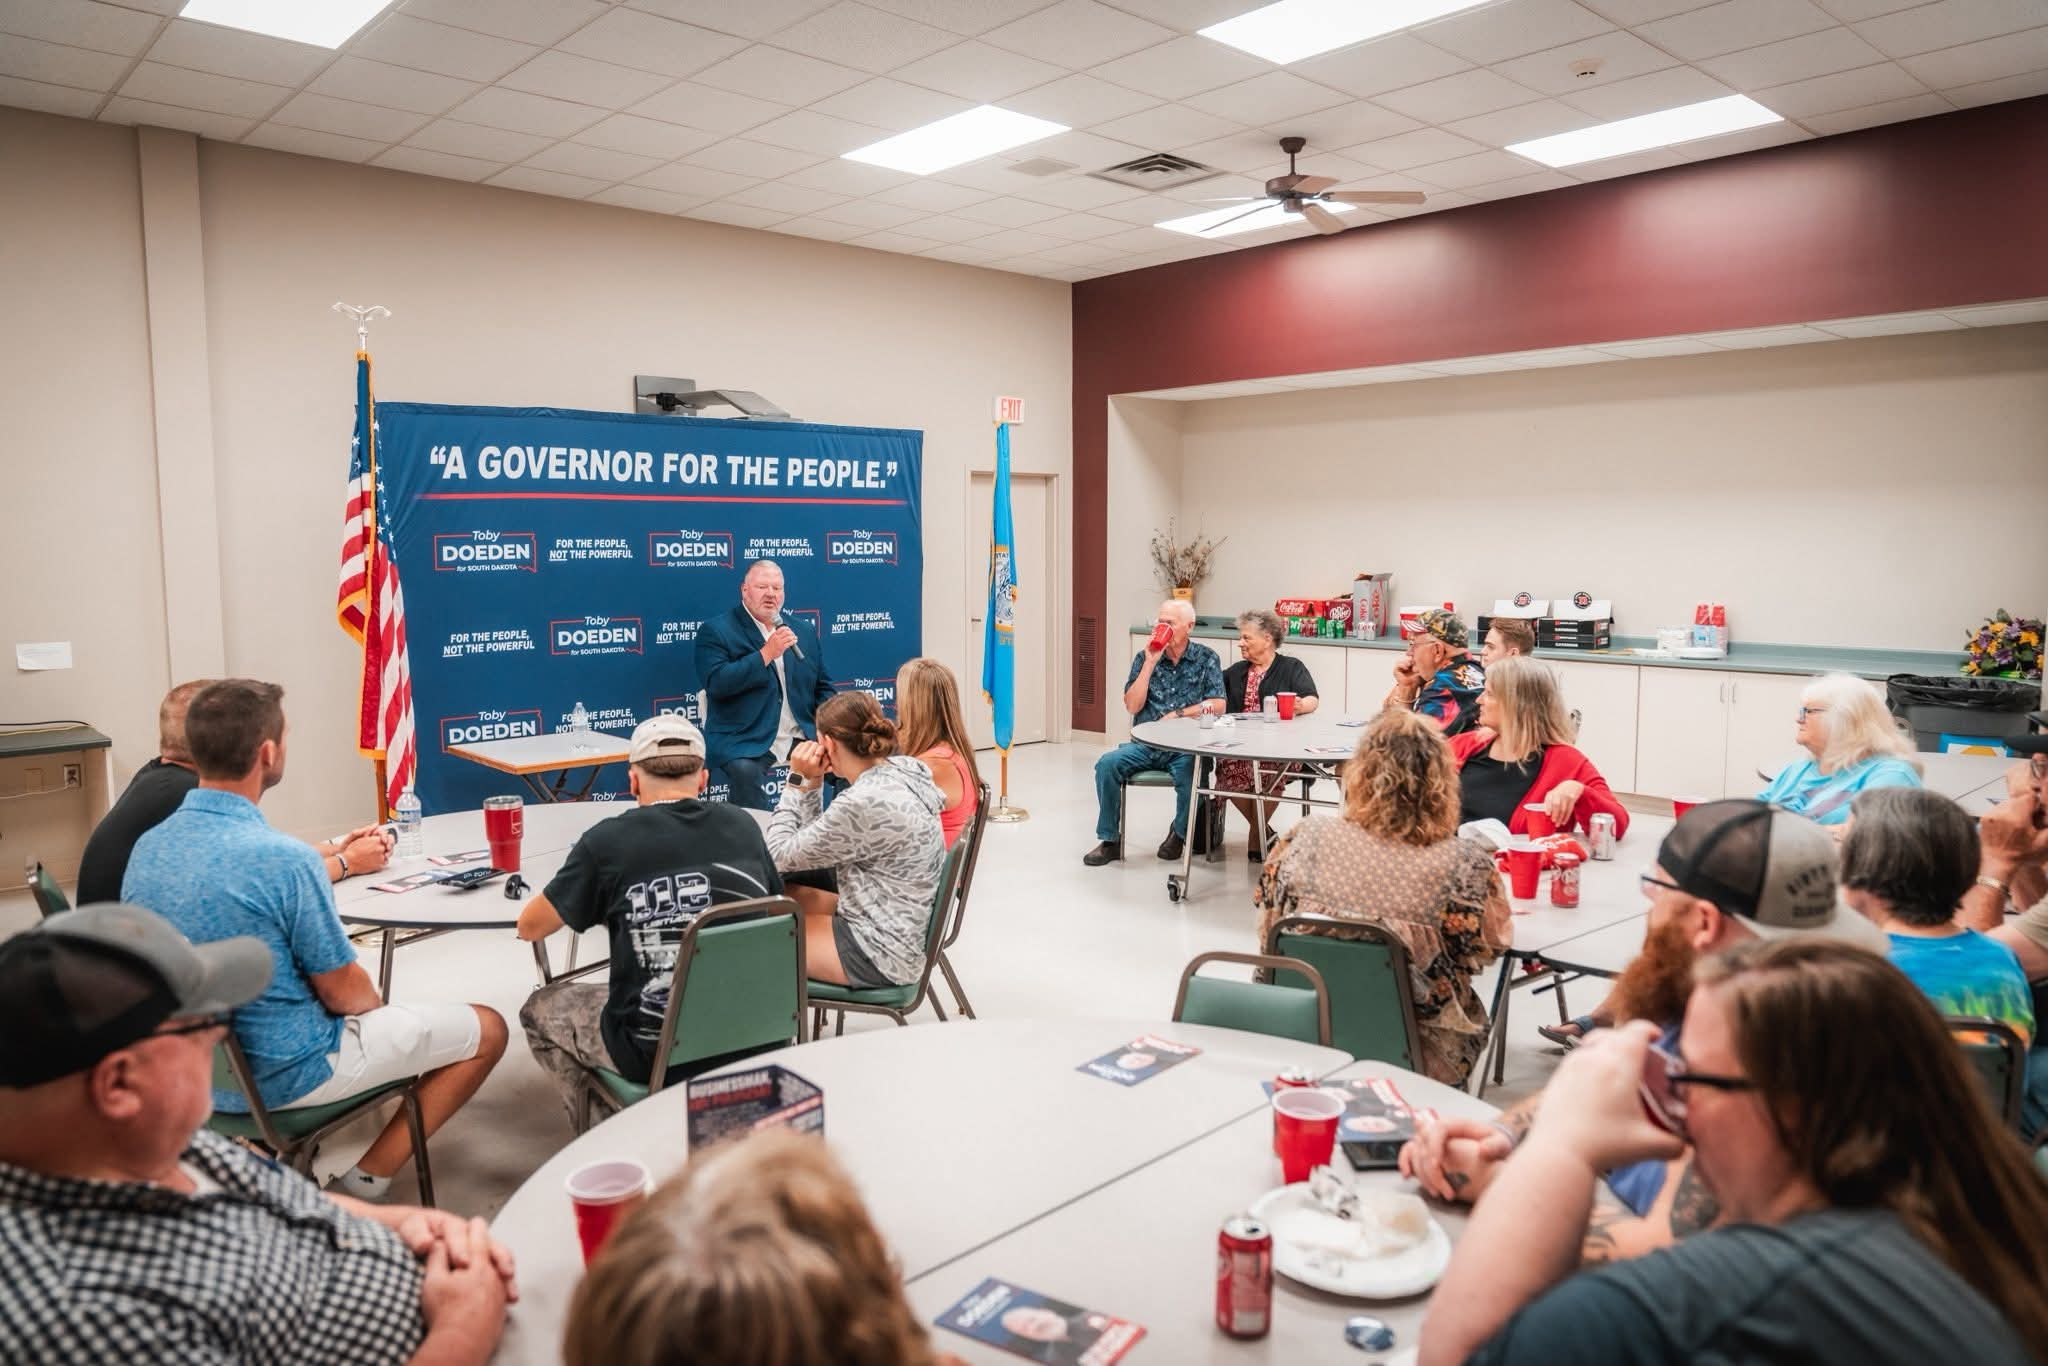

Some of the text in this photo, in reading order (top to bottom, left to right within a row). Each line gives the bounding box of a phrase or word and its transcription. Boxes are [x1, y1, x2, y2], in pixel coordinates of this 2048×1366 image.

[1001, 398, 1021, 421] EXIT
[478, 445, 653, 483] GOVERNOR
[662, 453, 718, 485] FOR
[727, 455, 779, 486] THE
[472, 529, 501, 542] Toby
[680, 529, 704, 541] Toby
[852, 529, 873, 540] Toby
[556, 539, 628, 549] FOR THE PEOPLE,
[750, 539, 810, 548] FOR THE PEOPLE,
[832, 541, 893, 555] DOEDEN
[442, 543, 530, 562] DOEDEN
[549, 550, 633, 561] NOT THE POWERFUL
[656, 542, 729, 558] DOEDEN
[744, 549, 815, 559] NOT THE POWERFUL
[584, 615, 610, 627] Toby
[836, 611, 892, 623] FOR THE PEOPLE,
[662, 622, 678, 632] FOR
[679, 621, 696, 631] THE
[831, 620, 895, 634] NOT THE POWERFUL
[450, 629, 530, 644] FOR THE PEOPLE,
[558, 627, 637, 647] DOEDEN
[656, 633, 673, 644] NOT
[674, 631, 691, 641] THE
[442, 640, 535, 657] NOT THE POWERFUL
[854, 677, 874, 688] Toby
[478, 709, 507, 722] Toby
[599, 708, 633, 719] PEOPLE,
[593, 718, 638, 730] POWERFUL
[448, 720, 536, 744] DOEDEN
[775, 768, 791, 778] Tob
[591, 791, 617, 802] Toby
